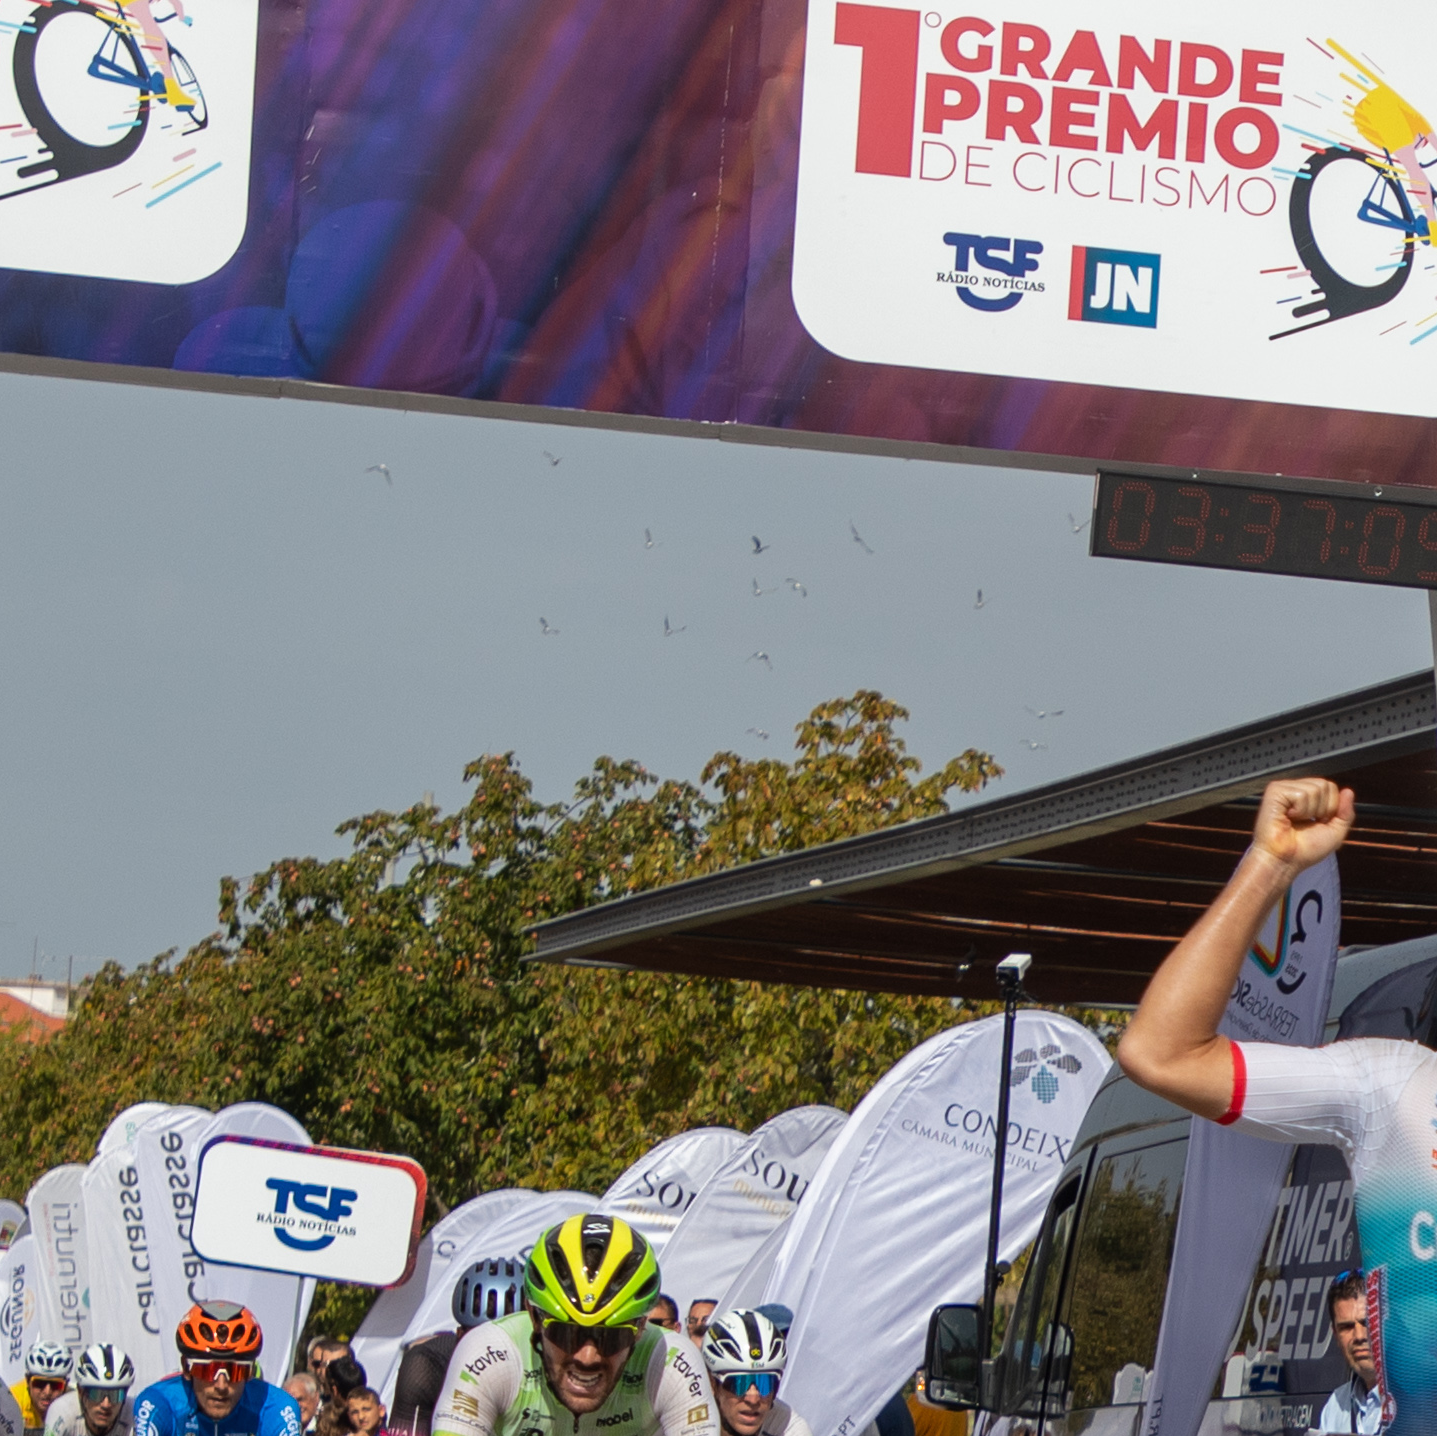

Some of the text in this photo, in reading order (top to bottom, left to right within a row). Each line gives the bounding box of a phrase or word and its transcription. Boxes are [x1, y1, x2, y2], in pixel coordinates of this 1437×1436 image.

[940, 16, 1285, 106] GRANDE
[919, 140, 1277, 216] DE CICLISMO
[943, 231, 1044, 278] TSF
[936, 271, 1046, 293] RÁDIO NOTÍCIAS
[1090, 261, 1153, 314] JN
[901, 1118, 1039, 1174] CÂMARA MUNCIPAL
[256, 1211, 357, 1237] RÁDIO NOTÍCIAS
[266, 1177, 358, 1221] TSF
[1265, 1180, 1355, 1268] TIMER
[1244, 1275, 1335, 1362] SPEED
[465, 1345, 511, 1377] tavfer
[672, 1351, 704, 1399] tavfer
